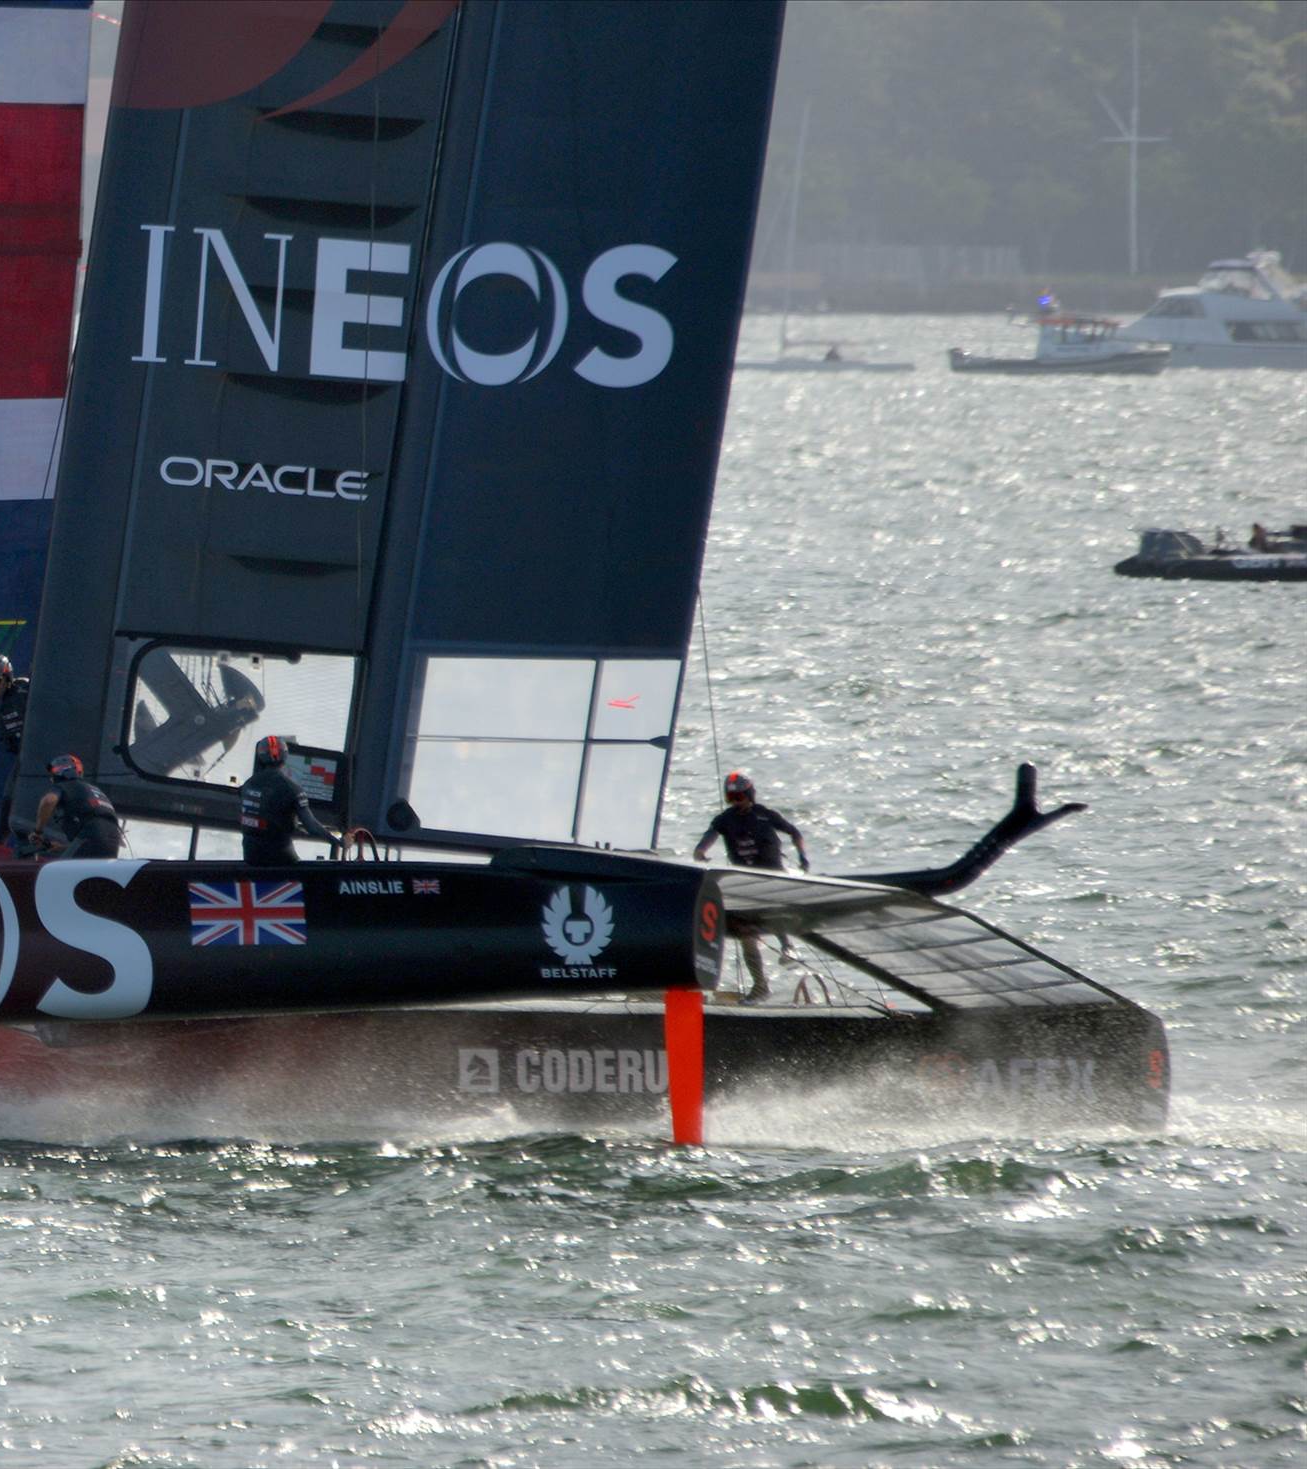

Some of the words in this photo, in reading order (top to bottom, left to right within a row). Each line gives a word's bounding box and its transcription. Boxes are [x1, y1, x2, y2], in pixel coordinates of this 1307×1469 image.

[131, 223, 679, 388] INEOS
[159, 456, 369, 501] ORACLE
[339, 880, 404, 895] AINSLIE
[540, 967, 618, 979] BELSTAFF
[516, 1049, 670, 1094] CODERU
